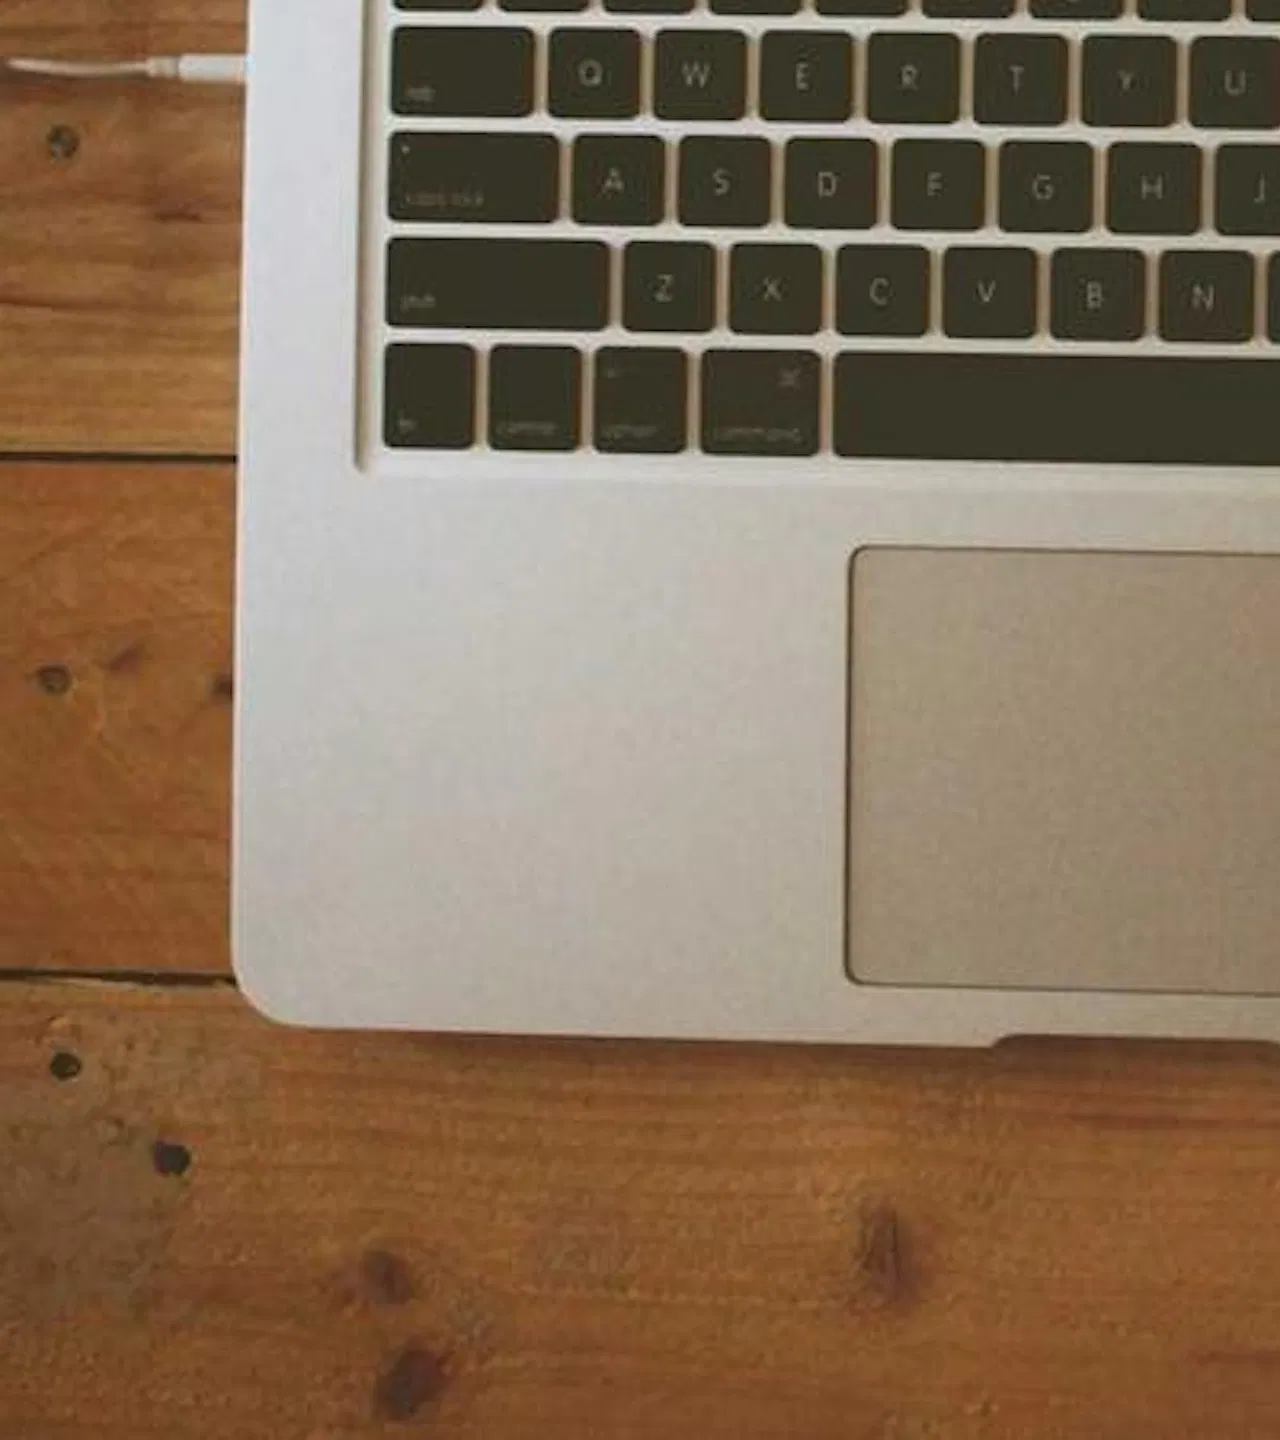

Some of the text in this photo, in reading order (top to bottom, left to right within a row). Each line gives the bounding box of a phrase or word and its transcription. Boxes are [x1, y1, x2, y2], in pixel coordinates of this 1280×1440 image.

[577, 58, 604, 87] Q
[681, 61, 711, 89] W
[794, 61, 810, 91] E
[900, 62, 920, 93] R
[1008, 64, 1026, 93] T
[1116, 67, 1136, 93] Y
[1223, 68, 1248, 98] U
[601, 166, 625, 194] A
[711, 166, 731, 197] S
[816, 169, 839, 199] D
[926, 170, 944, 198] F
[1030, 172, 1055, 202] G
[1140, 174, 1164, 201] H
[1252, 175, 1267, 205] J
[654, 273, 674, 303] Z
[762, 276, 782, 302] X
[868, 276, 890, 307] C
[976, 278, 998, 306] V
[1085, 280, 1106, 311] B
[1191, 282, 1215, 311] N
